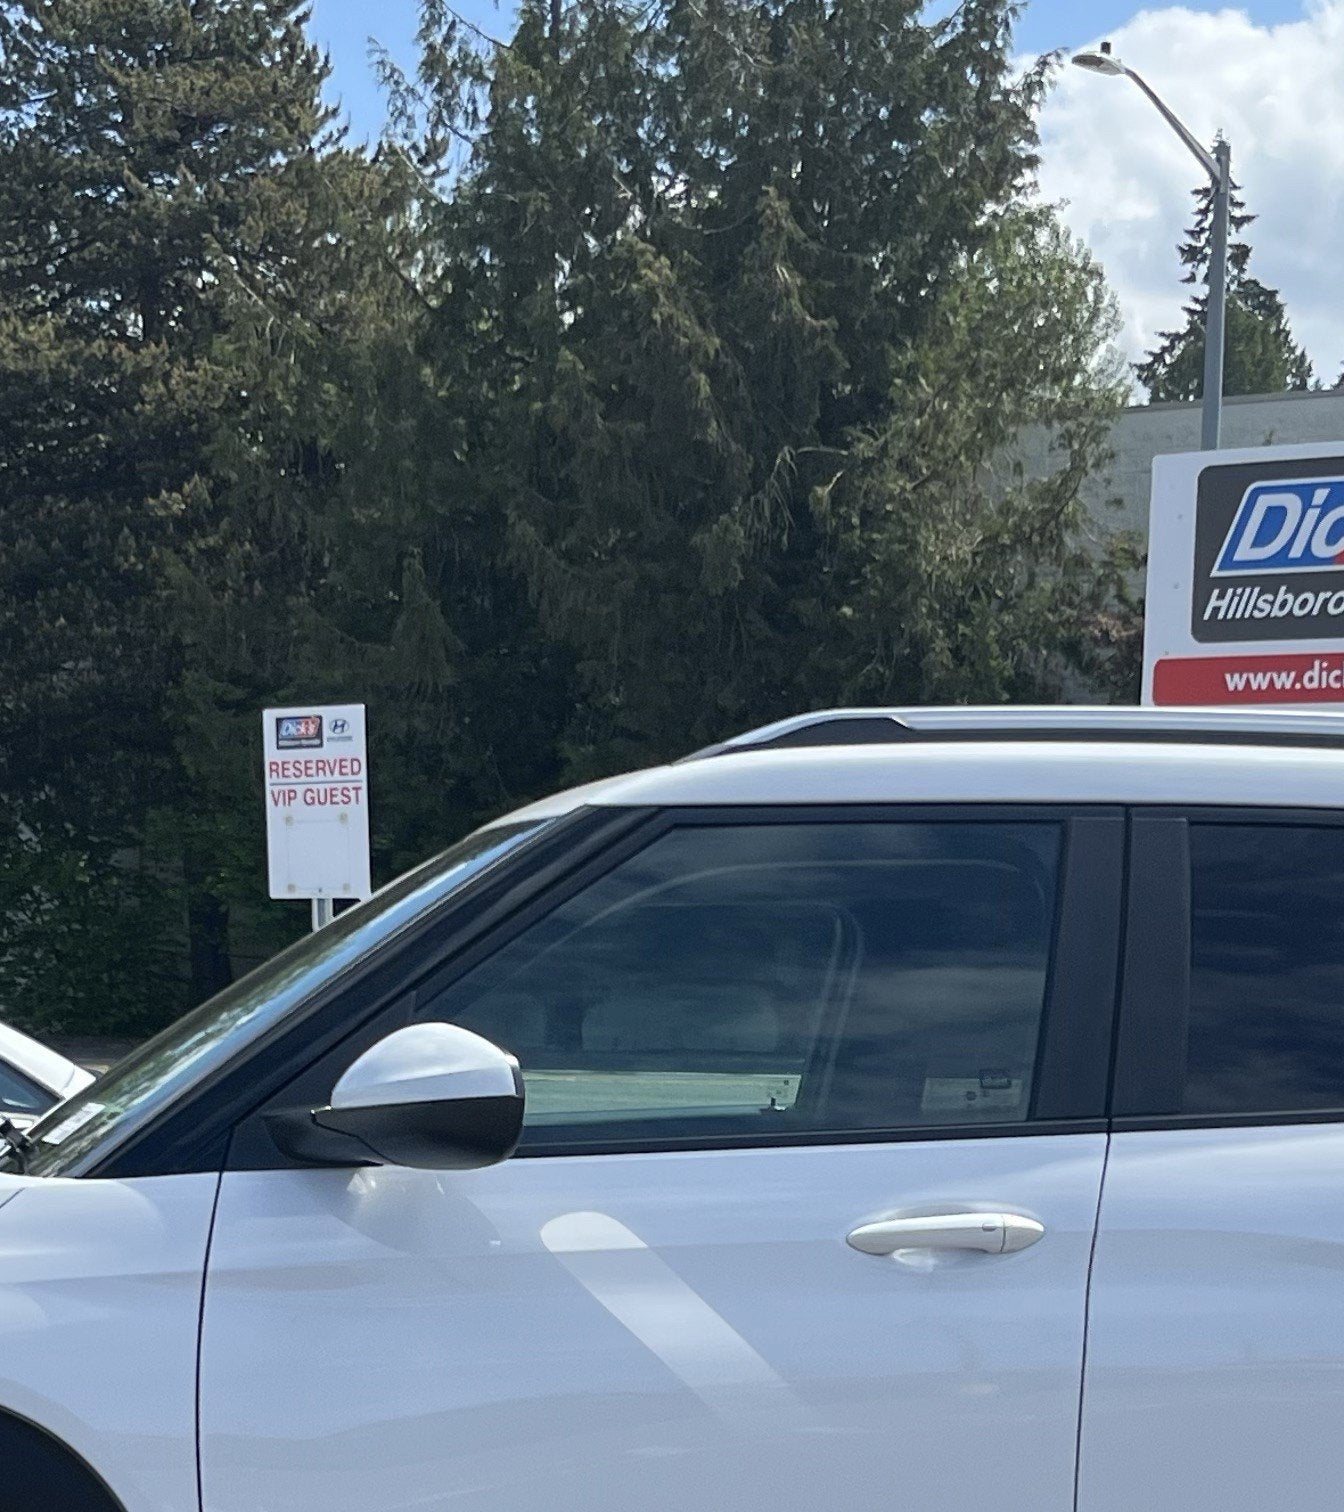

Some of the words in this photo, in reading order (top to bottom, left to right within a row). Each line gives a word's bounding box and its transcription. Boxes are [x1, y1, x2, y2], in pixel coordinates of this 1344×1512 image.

[269, 757, 362, 779] RESERVED
[270, 788, 297, 807] VIP
[303, 786, 362, 807] GUEST
